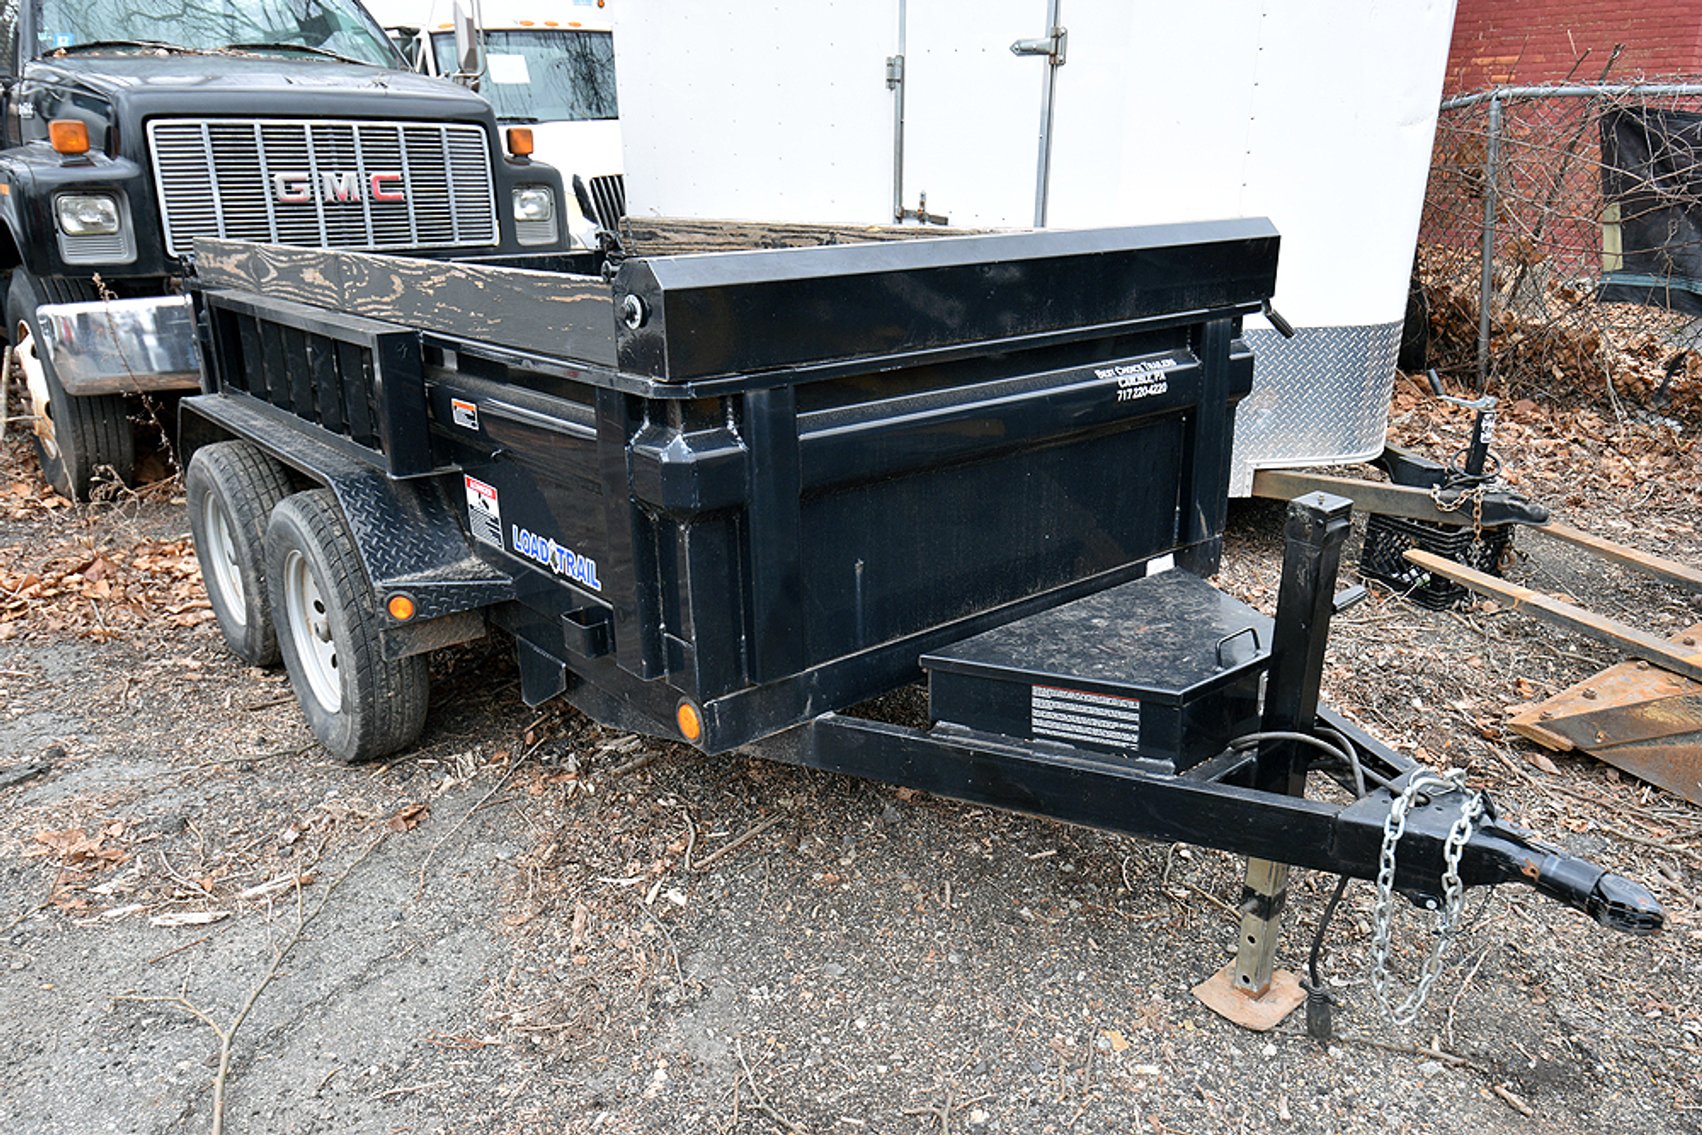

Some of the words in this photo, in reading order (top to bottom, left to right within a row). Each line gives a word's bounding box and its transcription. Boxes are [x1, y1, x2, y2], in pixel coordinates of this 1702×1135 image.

[273, 172, 404, 203] GMC
[512, 524, 549, 565] LOAD
[555, 544, 602, 591] TRAIL
